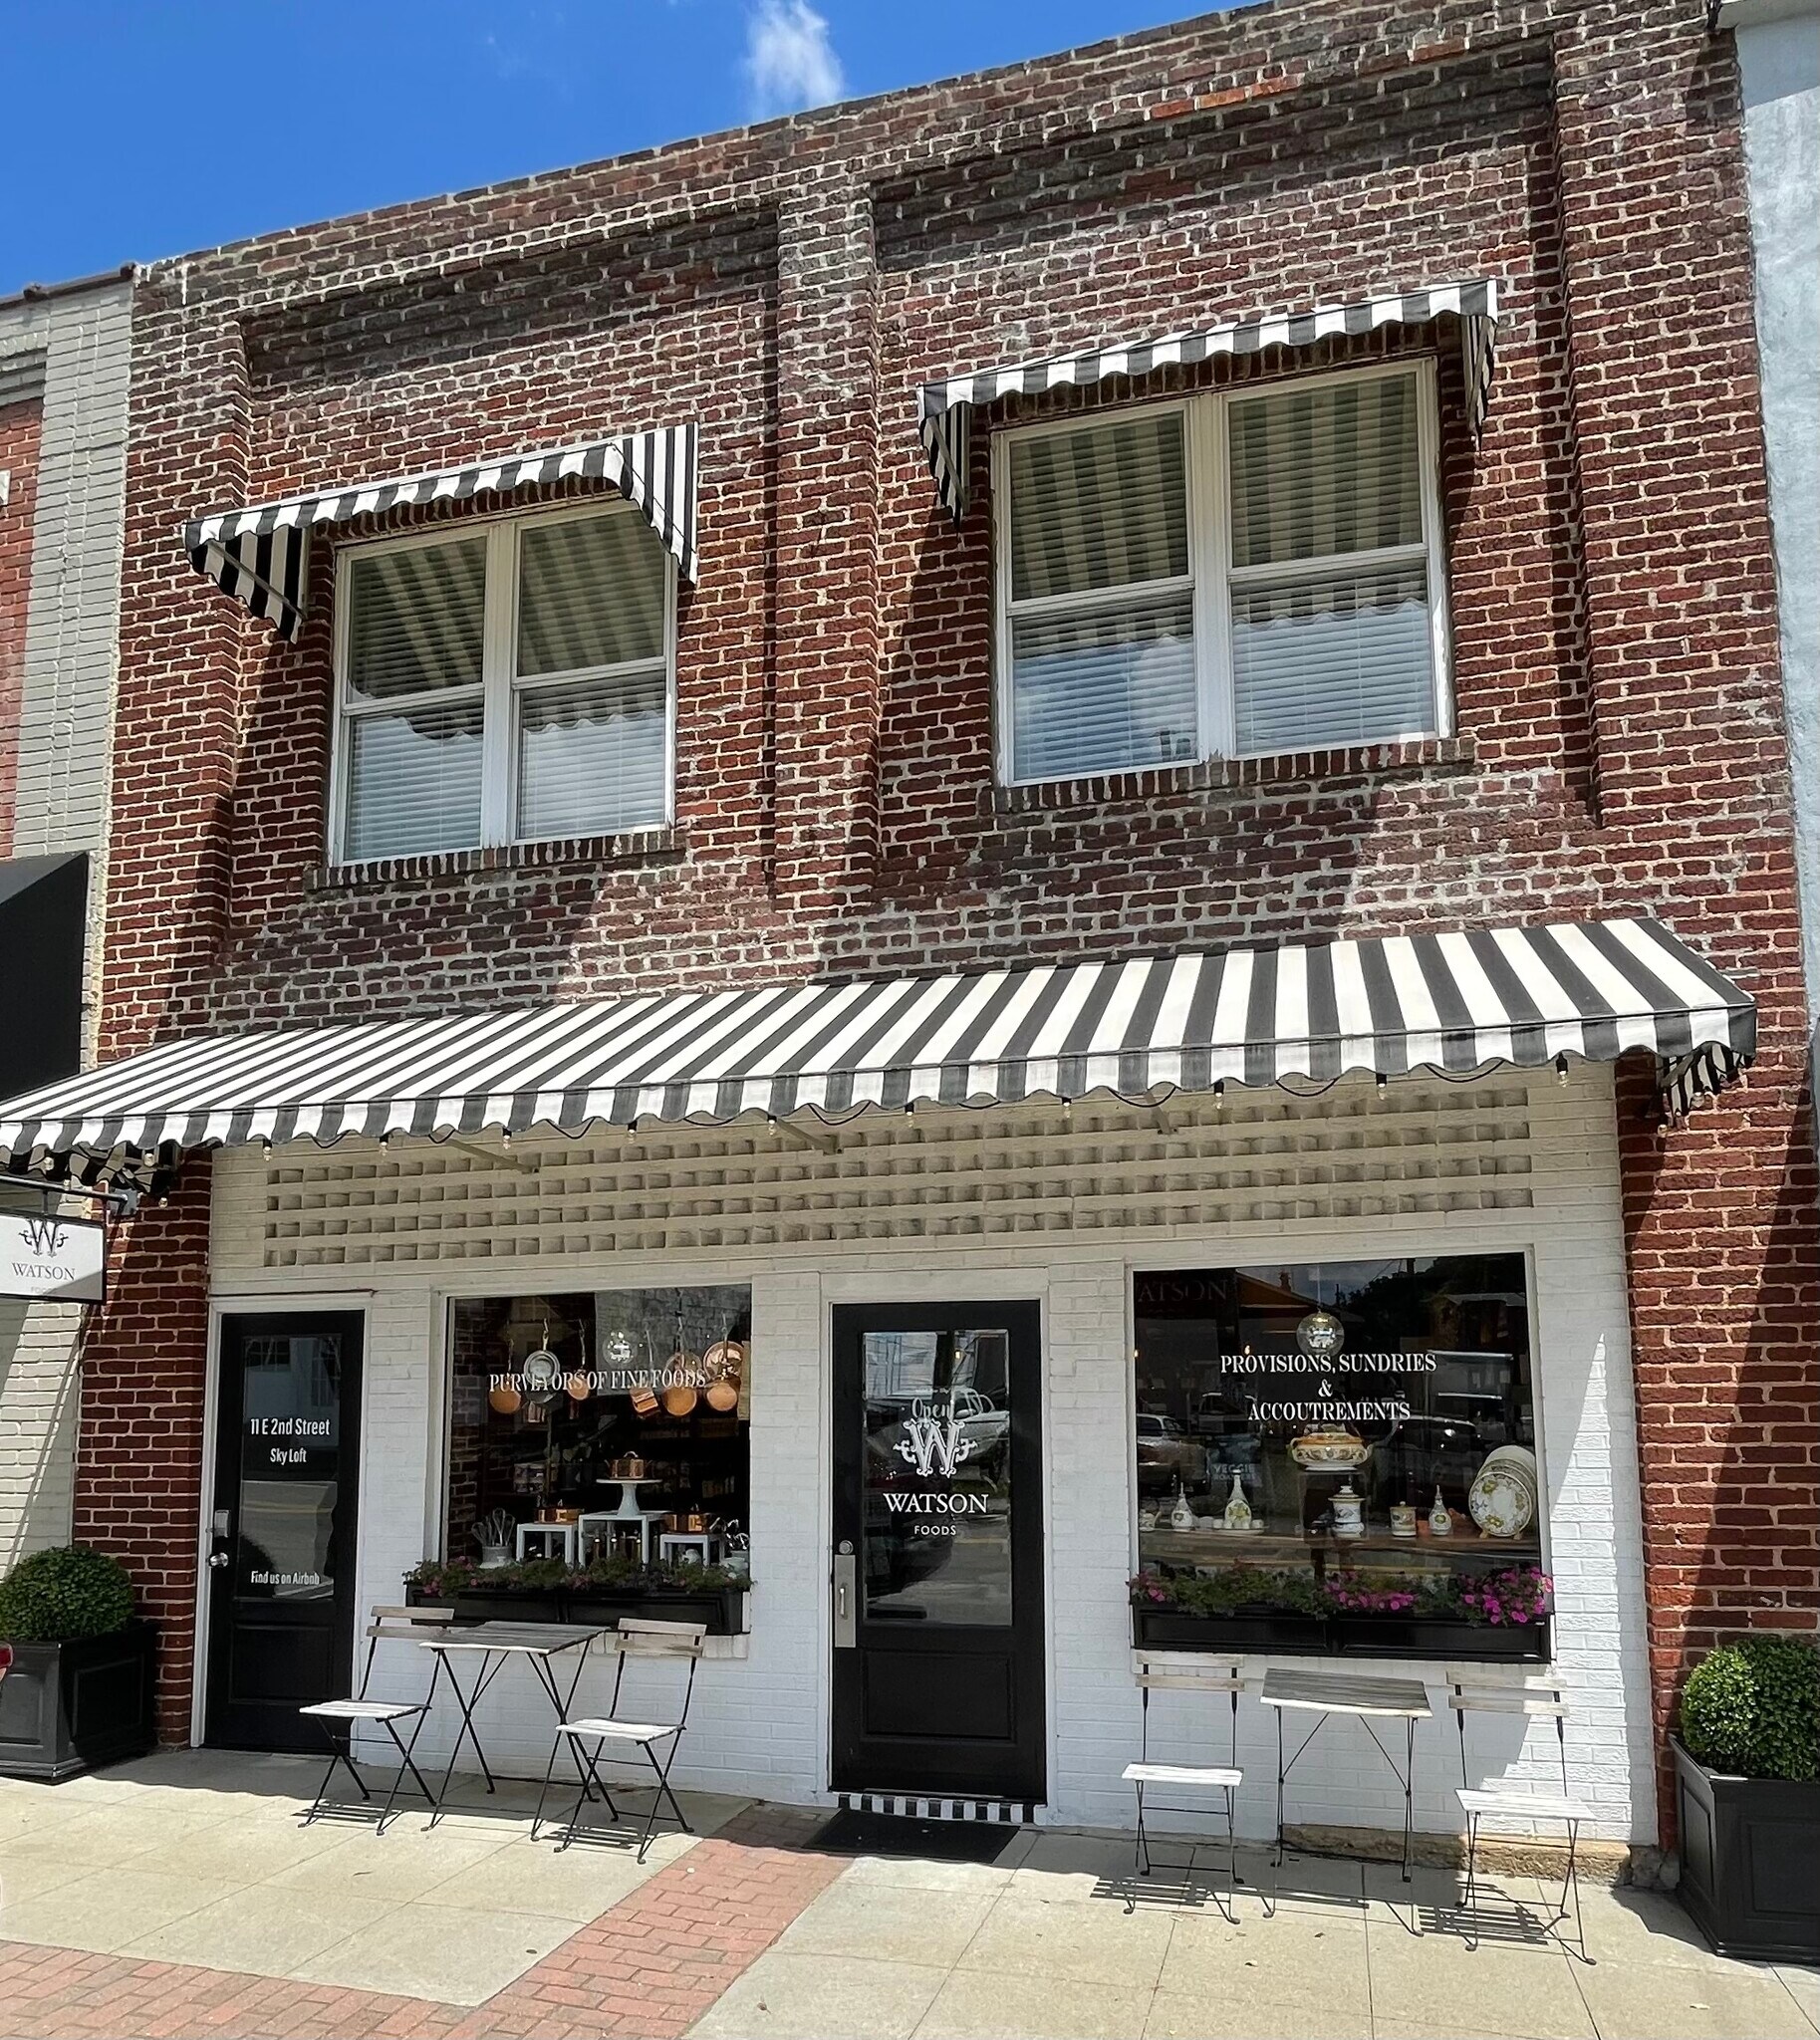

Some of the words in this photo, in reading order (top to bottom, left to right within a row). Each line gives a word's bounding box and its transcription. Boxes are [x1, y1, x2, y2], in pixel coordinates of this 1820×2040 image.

[12, 1262, 76, 1281] WATSON
[1134, 1279, 1228, 1302] ATSON
[1220, 1355, 1336, 1374] PROVISIONS,
[1339, 1353, 1437, 1373] SUNDRIES
[587, 1371, 609, 1390] OF
[611, 1369, 651, 1390] FINE
[651, 1368, 706, 1389] FOODS
[1318, 1379, 1333, 1398] &
[1247, 1402, 1411, 1421] ACCOUTREMENTS
[250, 1418, 260, 1435] 11
[262, 1418, 269, 1435] E
[270, 1417, 293, 1435] 2nd
[295, 1417, 331, 1435] Street
[269, 1447, 288, 1466] Sky
[288, 1447, 307, 1463] Loft
[883, 1492, 989, 1514] WATSON
[913, 1525, 956, 1536] FOODS
[250, 1570, 269, 1584] Find
[269, 1574, 280, 1585] us
[280, 1574, 292, 1585] on
[292, 1571, 320, 1586] Airbnb
